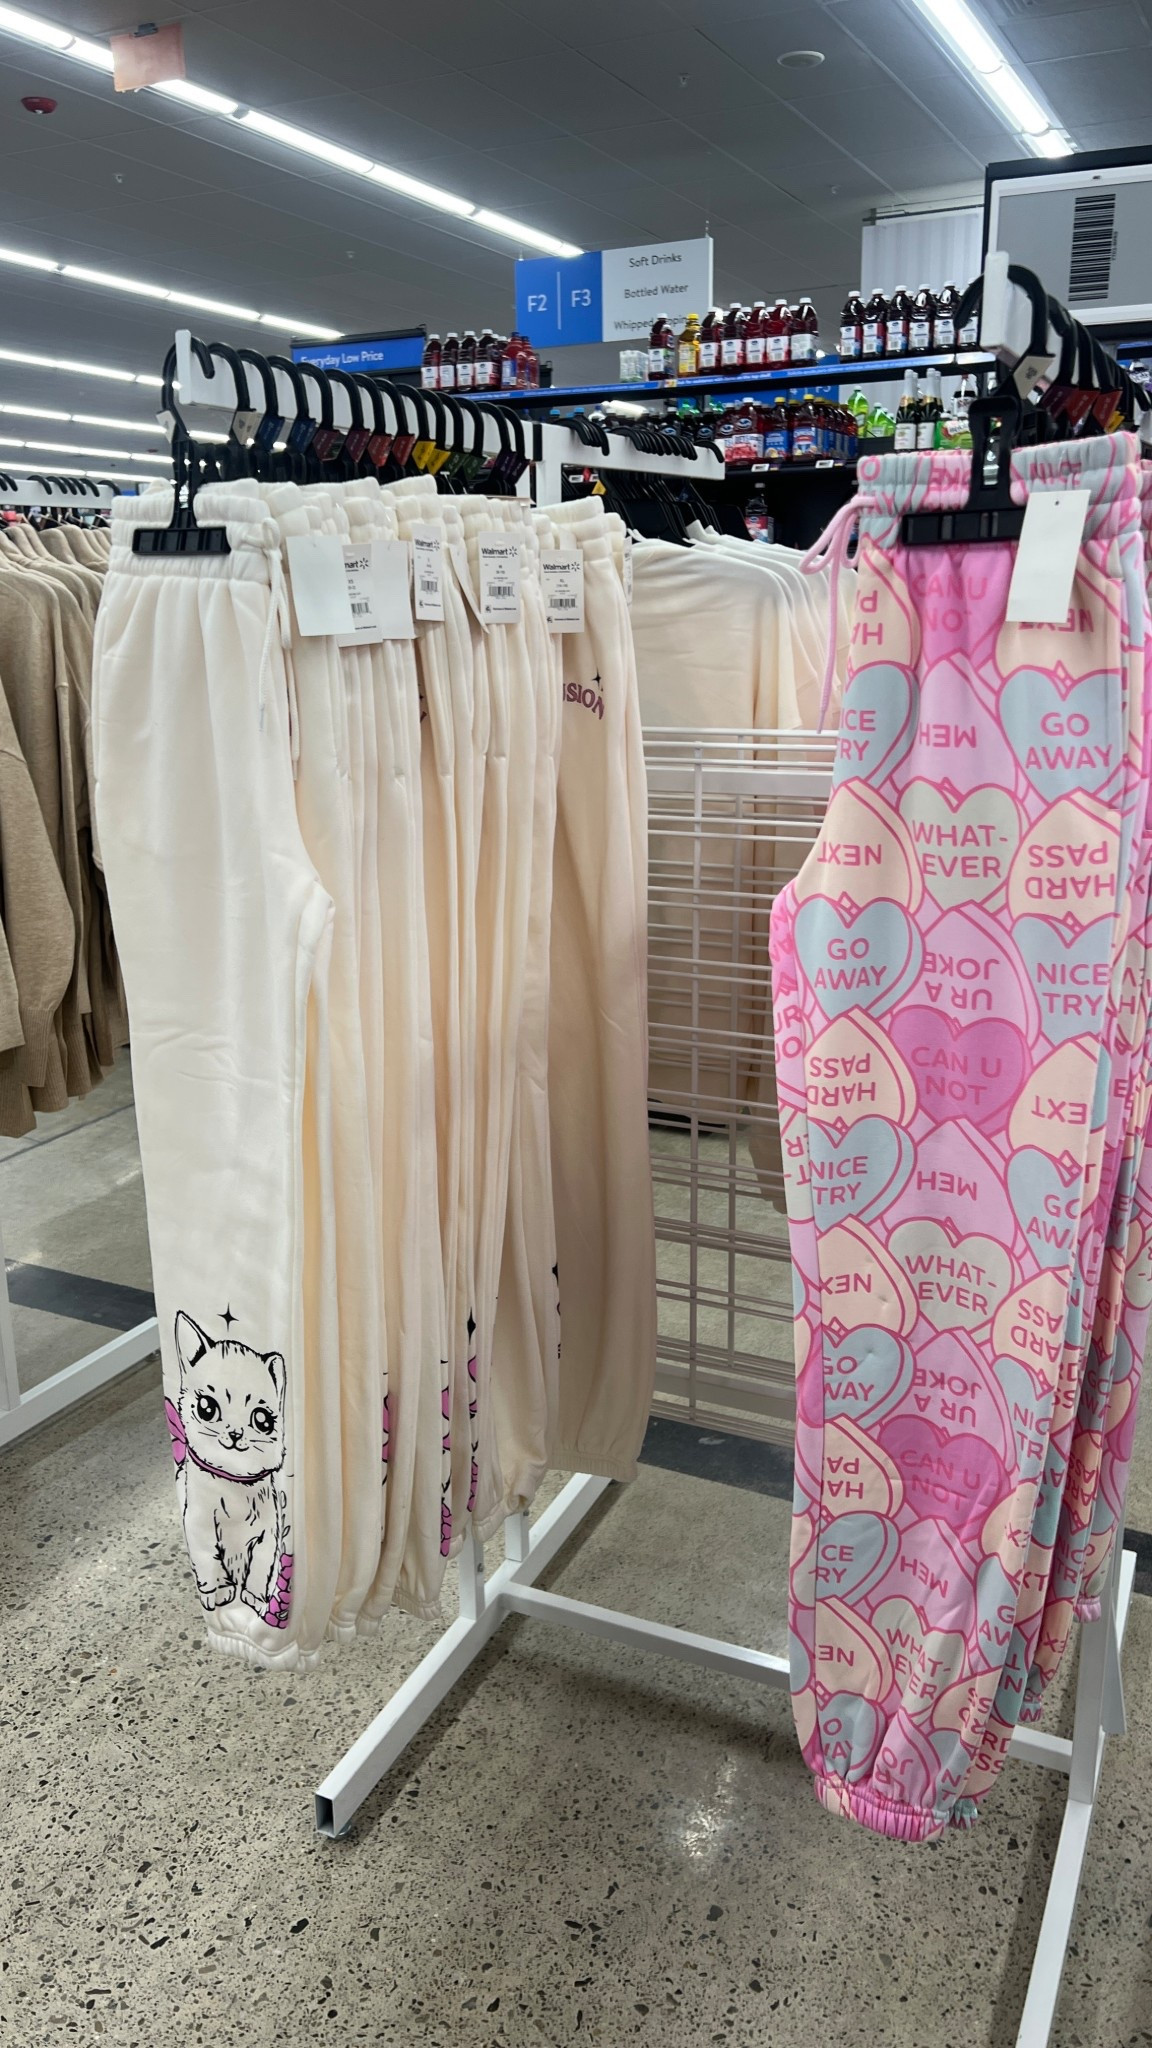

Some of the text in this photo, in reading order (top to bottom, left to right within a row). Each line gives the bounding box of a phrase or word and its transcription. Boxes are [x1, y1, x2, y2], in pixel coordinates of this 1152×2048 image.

[629, 253, 683, 268] Soft Drinks
[527, 294, 548, 312] F2
[571, 289, 591, 307] F3
[624, 284, 689, 299] Bottled Water
[614, 317, 654, 331] Whipped
[341, 352, 359, 364] Low
[361, 350, 384, 362] Price
[860, 455, 881, 481] O
[481, 547, 508, 556] Walmart
[344, 560, 359, 569] mart
[543, 563, 570, 571] Walmart
[911, 573, 988, 601] CAN U
[924, 606, 973, 633] NO
[1018, 608, 1094, 633] NE
[841, 709, 877, 732] ICE
[1040, 712, 1091, 737] GO
[919, 724, 977, 749] MEH
[837, 737, 870, 762] RY
[1025, 744, 1113, 771] AWAY
[912, 820, 1008, 847] WHAT-
[817, 841, 883, 867] NEXT
[921, 853, 1002, 879] EVER
[1028, 840, 1108, 868] PASS
[1024, 873, 1116, 900] HARD
[827, 938, 870, 961] GO
[923, 951, 1001, 980] JOKE
[1036, 962, 1113, 986] NICE
[814, 966, 888, 991] AWAY
[925, 981, 993, 1011] UR A
[1041, 992, 1104, 1017] TRY
[809, 1054, 871, 1079] PASS
[910, 1046, 1002, 1080] CAN U
[806, 1082, 877, 1108] HARD
[925, 1075, 989, 1106] NOT
[1031, 1095, 1088, 1126] EXT
[808, 1156, 869, 1181] NICE
[812, 1182, 863, 1206] TRY
[916, 1171, 978, 1202] MEH
[1026, 1220, 1074, 1250] AW
[819, 1273, 872, 1295] NEX
[904, 1255, 998, 1290] WHAT-
[917, 1281, 989, 1316] EVER
[1017, 1298, 1064, 1334] ASS
[1010, 1325, 1062, 1363] ARD
[823, 1381, 875, 1401] WAY
[912, 1368, 982, 1400] JOKE
[914, 1393, 977, 1428] UR A
[1014, 1402, 1053, 1436] NIC
[1016, 1430, 1044, 1461] TR
[826, 1456, 860, 1475] PA
[900, 1450, 981, 1490] CAN U
[826, 1479, 864, 1500] HA
[911, 1473, 968, 1511] NOT
[820, 1544, 855, 1562] CE
[808, 1565, 848, 1585] RY
[900, 1554, 949, 1599] MEH
[996, 1604, 1016, 1624] G
[978, 1622, 1012, 1647] AW
[818, 1643, 855, 1667] NE
[886, 1627, 952, 1678] WHAT-
[822, 1717, 843, 1736] O
[981, 1730, 1012, 1754] RD
[881, 1746, 915, 1777] JO
